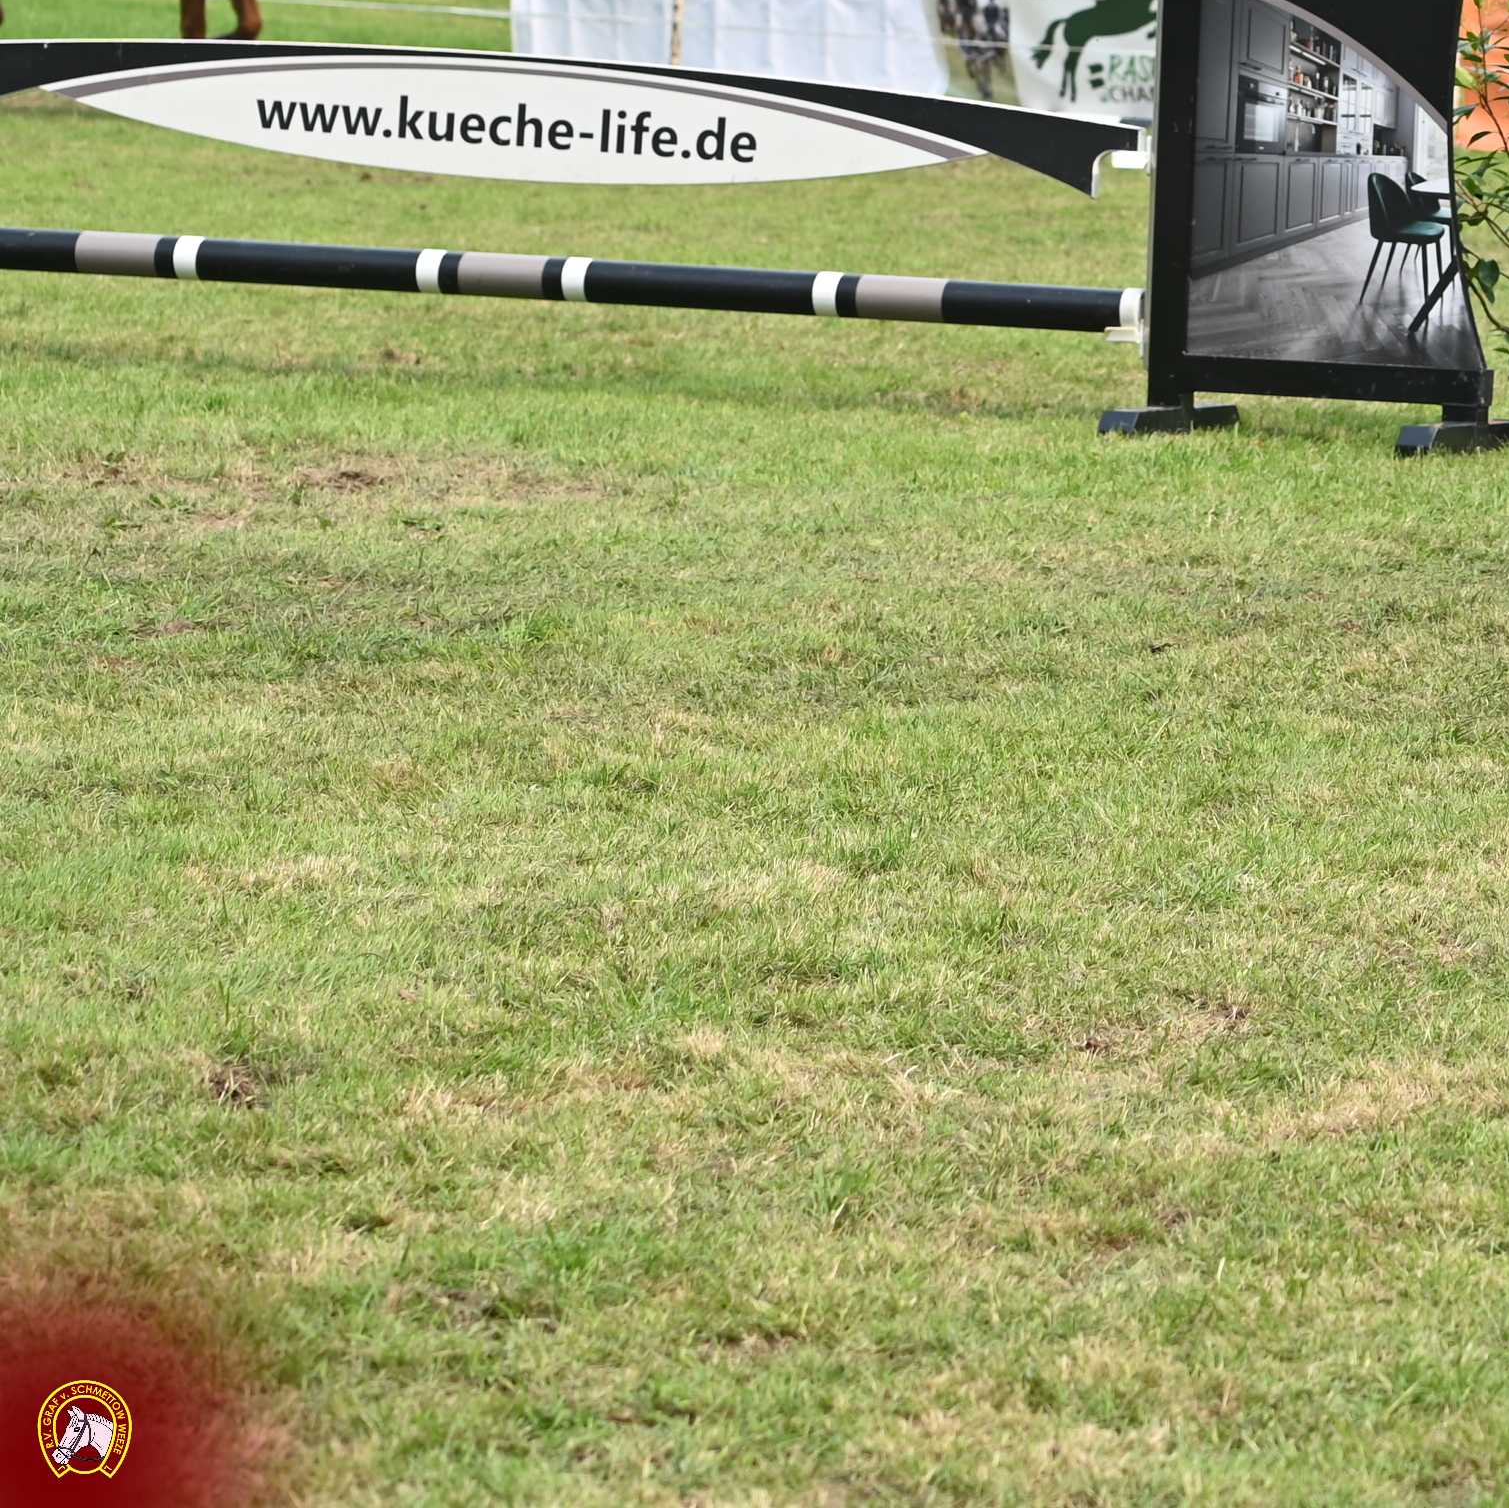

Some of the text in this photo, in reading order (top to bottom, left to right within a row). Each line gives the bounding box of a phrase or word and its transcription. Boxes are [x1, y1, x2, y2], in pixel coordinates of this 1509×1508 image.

[1109, 54, 1156, 83] RAS
[1108, 85, 1155, 103] CHA
[256, 94, 757, 163] www.kueche-life.de
